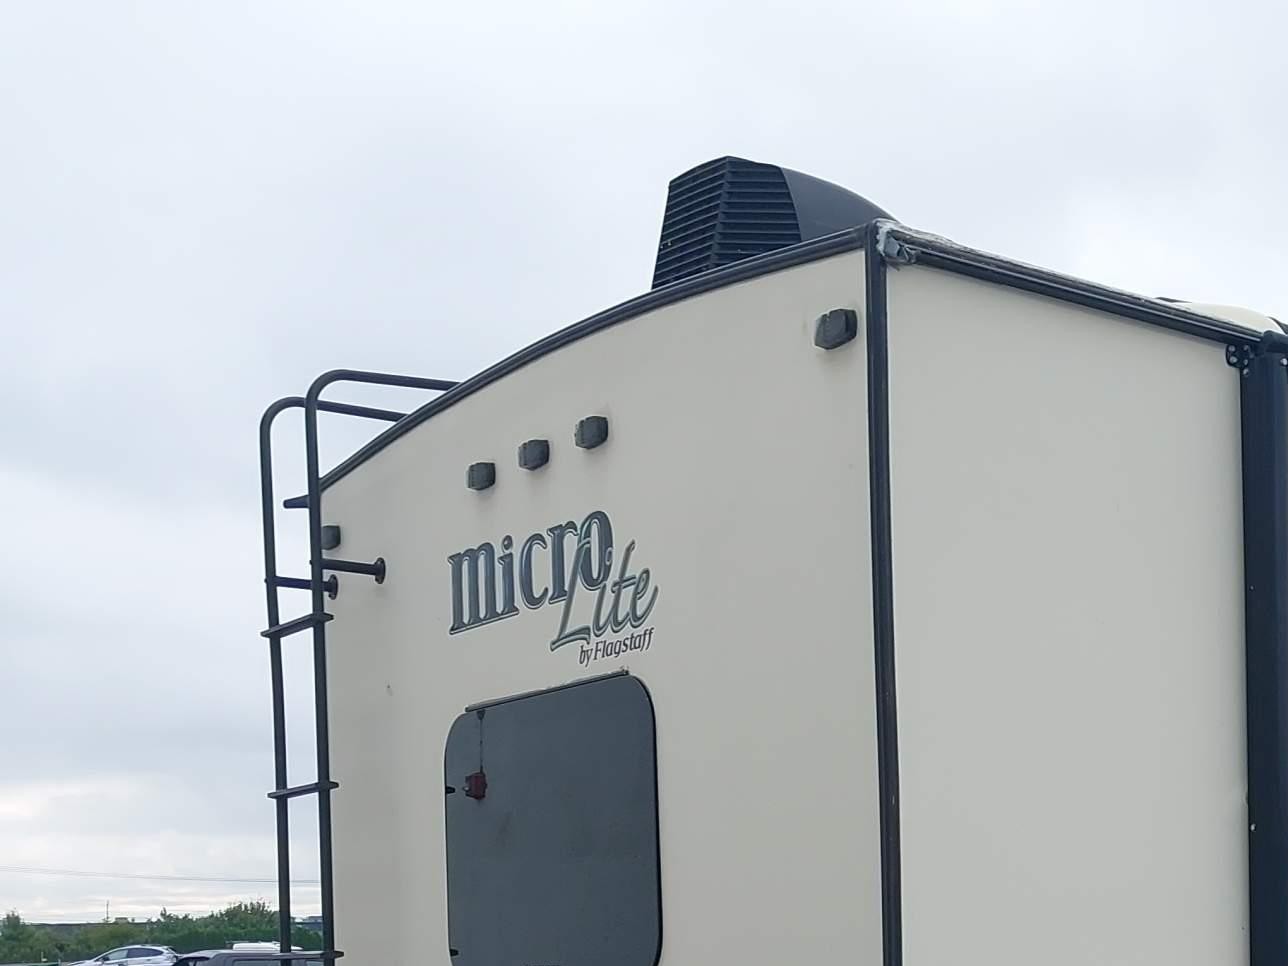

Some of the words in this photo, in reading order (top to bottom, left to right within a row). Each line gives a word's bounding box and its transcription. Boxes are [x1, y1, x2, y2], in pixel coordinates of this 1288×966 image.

[447, 510, 614, 636] micro
[550, 539, 659, 652] Lite
[578, 644, 593, 666] by
[593, 627, 655, 661] Flagstaff
